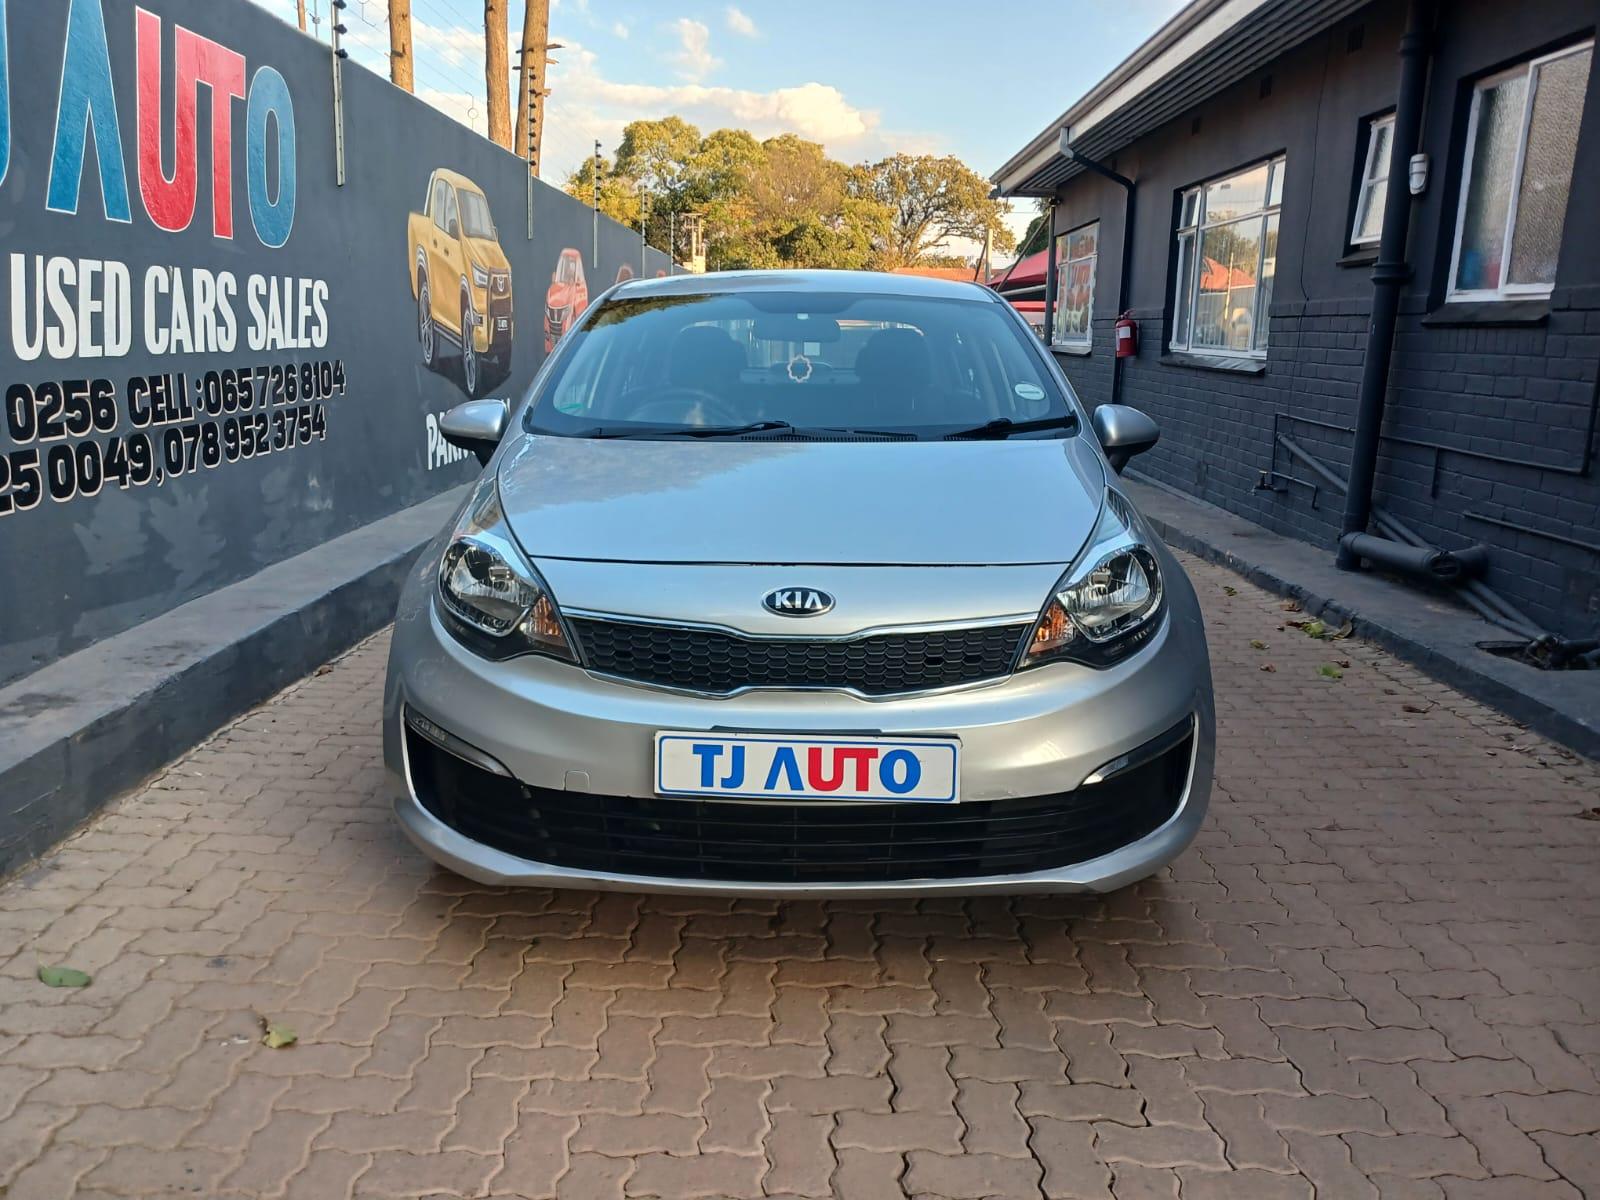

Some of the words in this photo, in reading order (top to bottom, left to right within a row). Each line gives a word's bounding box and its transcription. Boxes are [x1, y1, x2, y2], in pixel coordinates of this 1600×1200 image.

[46, 0, 296, 248] AUTO
[10, 253, 132, 361] USED
[144, 265, 238, 355] CARS
[247, 273, 329, 351] SALES
[6, 379, 119, 444] 0256
[774, 590, 824, 610] KIA
[692, 743, 746, 789] TJ
[763, 746, 922, 794] AUTO
